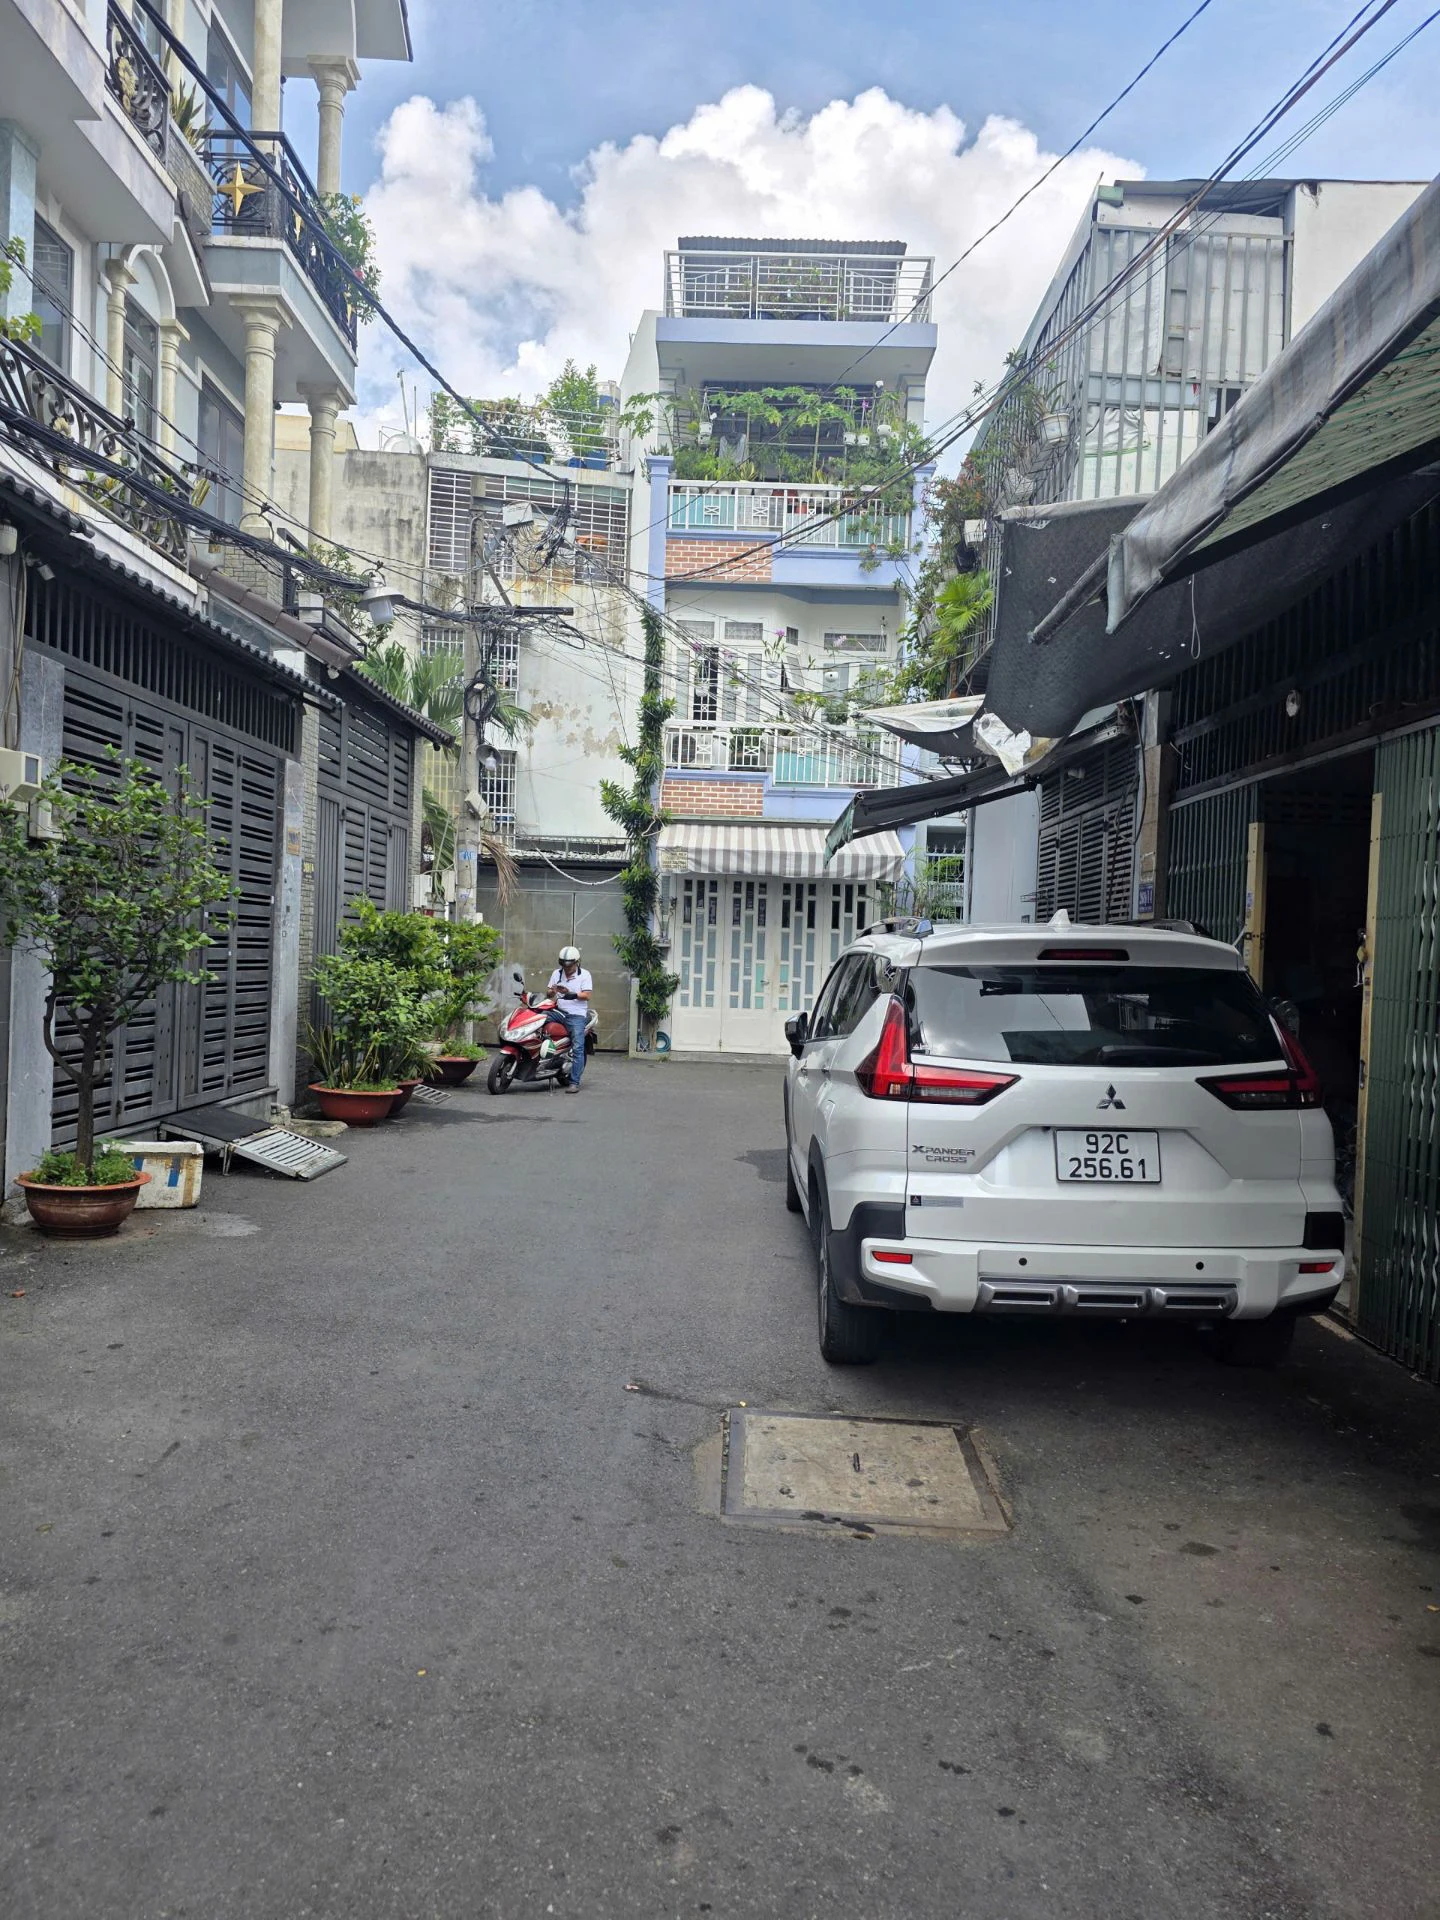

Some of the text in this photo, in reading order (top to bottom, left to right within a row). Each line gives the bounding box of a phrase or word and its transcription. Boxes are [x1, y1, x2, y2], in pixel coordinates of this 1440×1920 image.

[911, 1144, 976, 1156] XPANDER
[1086, 1133, 1129, 1155] 92C
[925, 1155, 968, 1163] CROSS
[1069, 1157, 1146, 1179] 256.61
